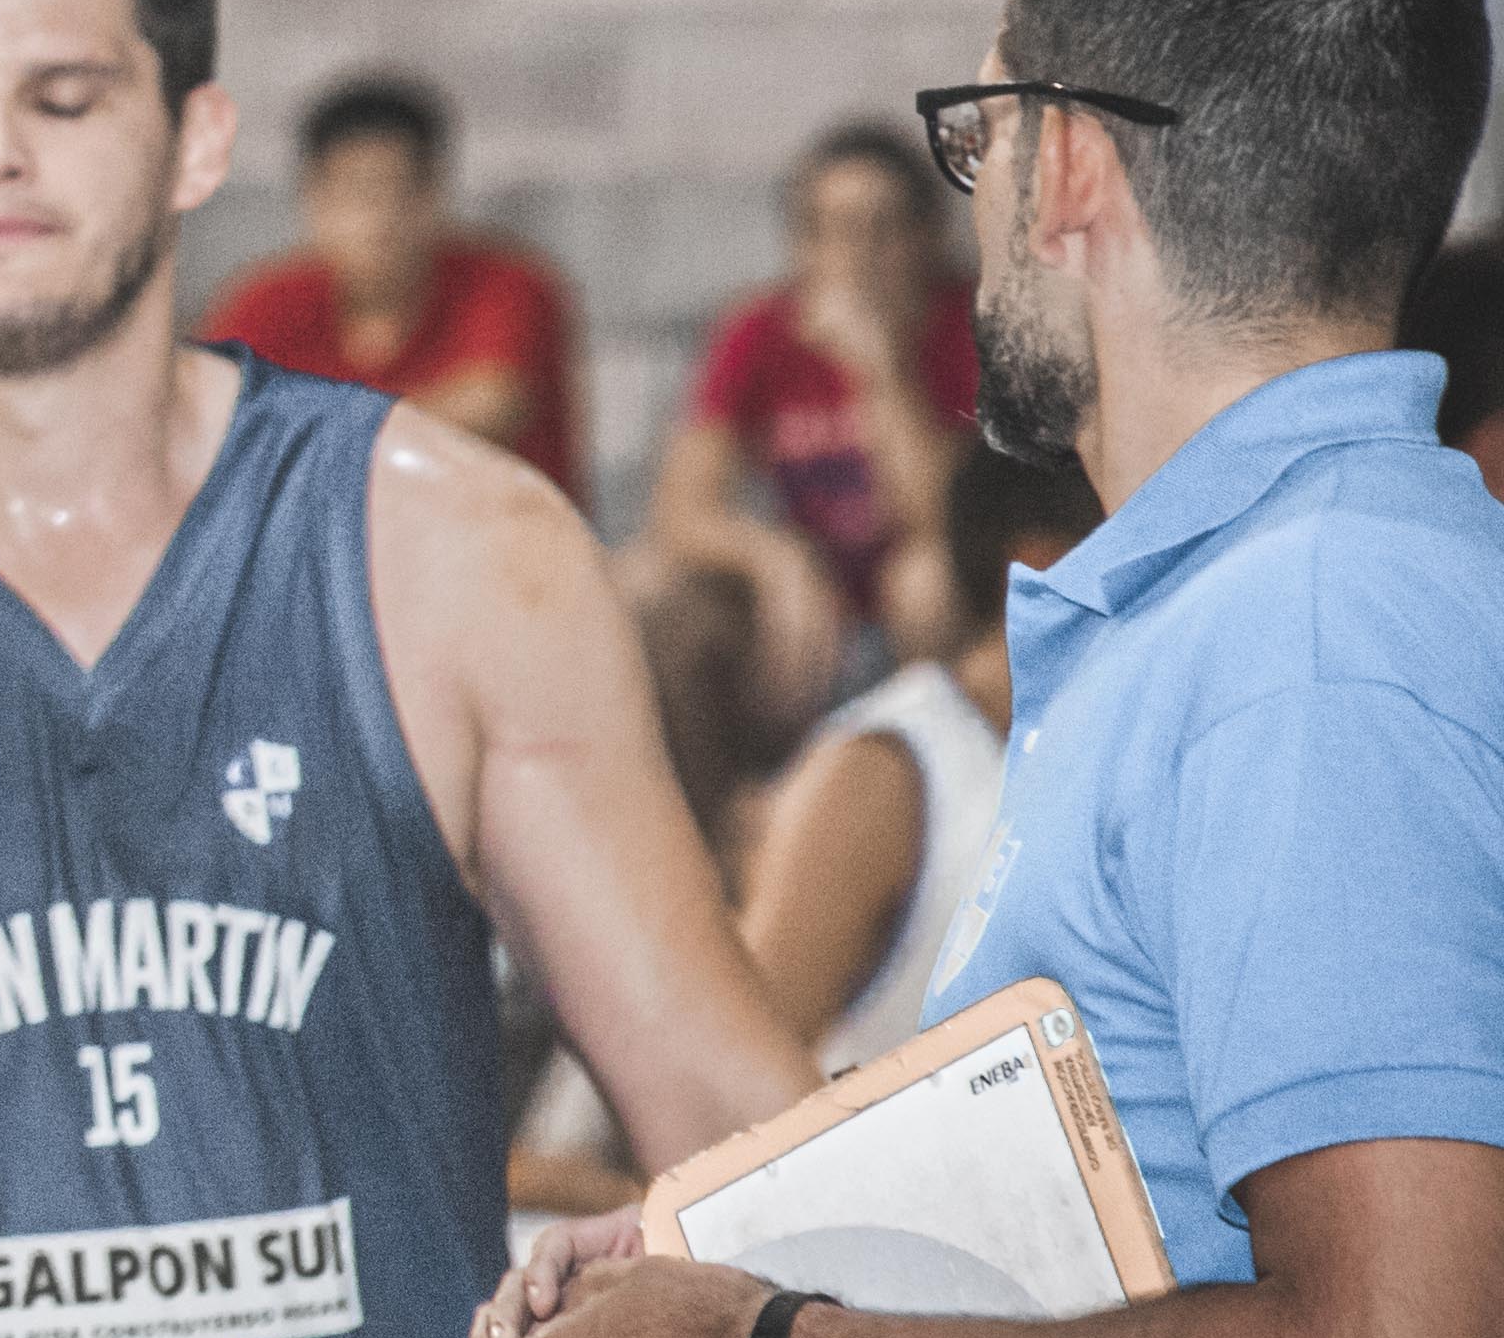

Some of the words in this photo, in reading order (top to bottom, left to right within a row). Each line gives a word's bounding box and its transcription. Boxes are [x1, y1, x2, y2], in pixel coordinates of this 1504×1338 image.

[46, 898, 336, 1033] MARTIN
[76, 1042, 161, 1148] 15
[970, 1056, 1025, 1096] ENEBA
